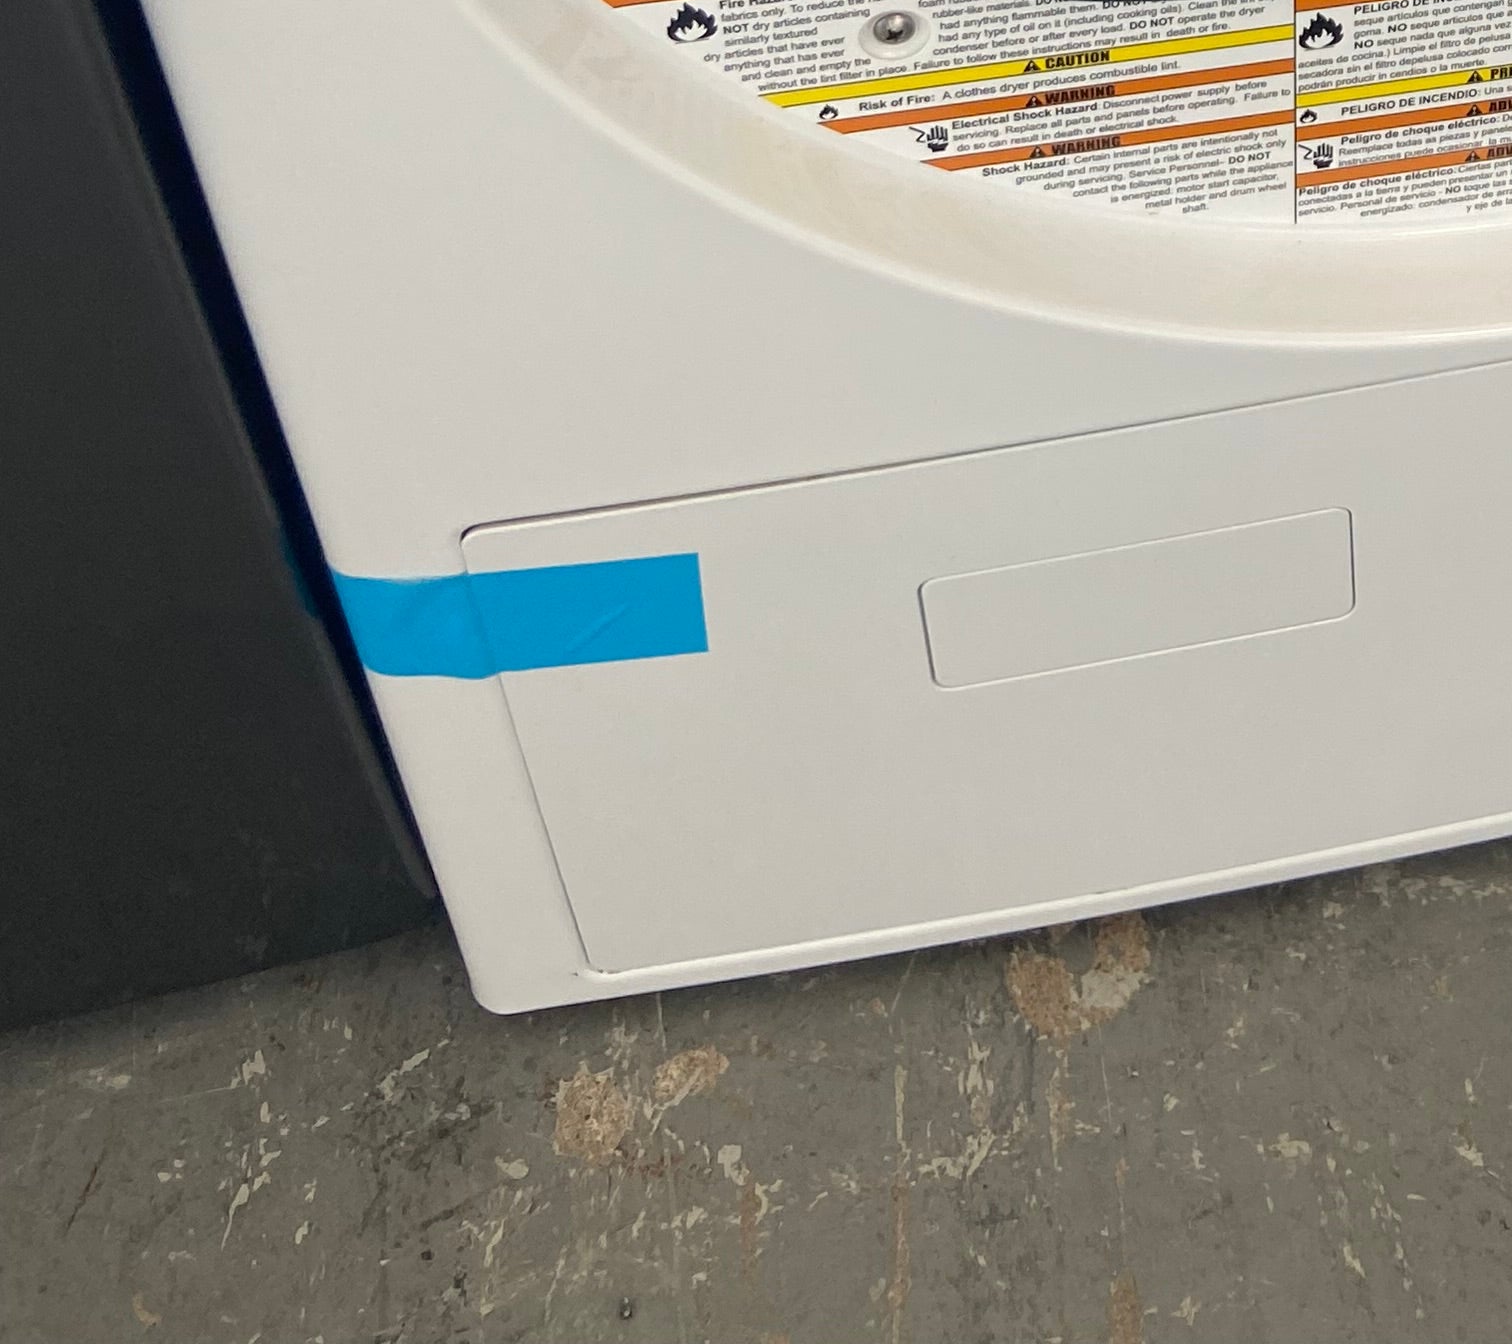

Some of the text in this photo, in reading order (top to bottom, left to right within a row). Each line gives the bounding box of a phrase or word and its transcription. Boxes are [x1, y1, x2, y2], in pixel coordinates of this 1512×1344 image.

[723, 6, 869, 35] NOT dry articles containing
[1045, 49, 1110, 70] CAUTION
[859, 99, 886, 112] Risk
[891, 96, 903, 107] of
[906, 92, 934, 106] Fire:
[942, 90, 951, 101] A
[953, 84, 995, 99] clothes
[999, 79, 1029, 95] dryer
[1033, 71, 1085, 90] produces
[1089, 61, 1156, 81] combustible
[1045, 83, 1115, 105] WARNING
[1341, 99, 1395, 117] PELIGRO
[1399, 96, 1415, 108] DE
[952, 113, 1009, 131] Electrical
[1013, 107, 1051, 122] Shock
[1051, 134, 1120, 156] WARNING
[982, 162, 1019, 178] Shock
